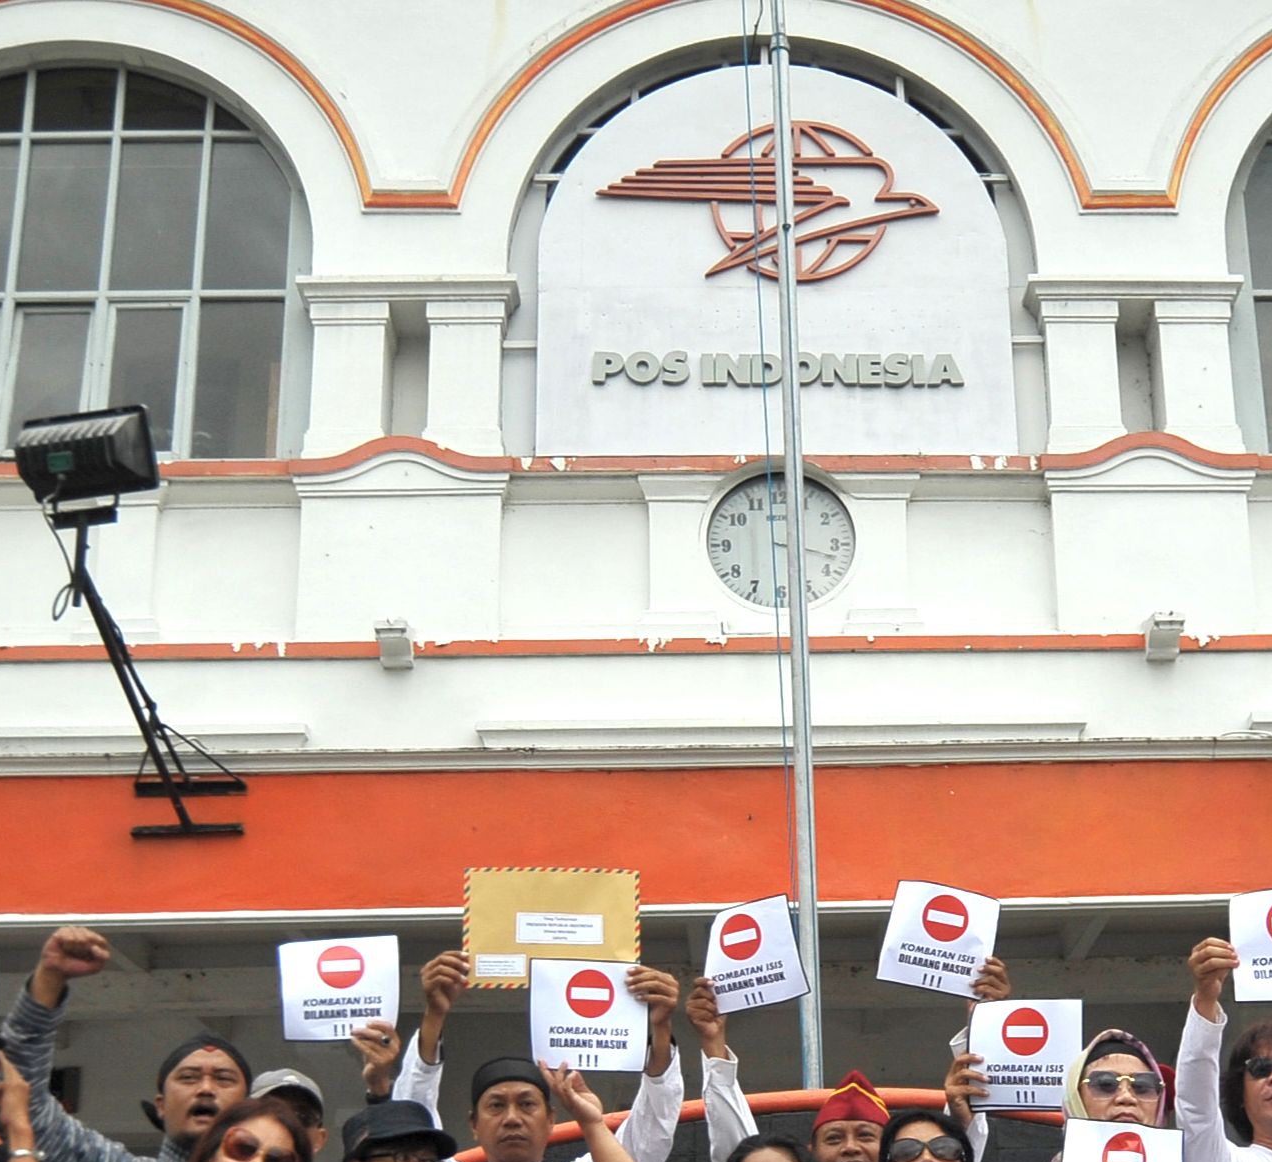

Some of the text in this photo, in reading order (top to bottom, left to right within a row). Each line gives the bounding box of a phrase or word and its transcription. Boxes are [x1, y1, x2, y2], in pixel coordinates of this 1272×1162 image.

[592, 350, 965, 388] POS INDONESIA
[748, 499, 764, 511] 11
[730, 513, 747, 526] 10
[820, 512, 830, 525] 2
[721, 539, 732, 552] 9
[830, 538, 840, 551] 3
[731, 564, 741, 578] 8
[821, 563, 831, 577] 4
[750, 580, 759, 593] 7
[776, 585, 787, 599] 6
[900, 943, 976, 964] KOMBATAN ISIS
[711, 960, 783, 982] KOMBATAN ISIS
[898, 953, 972, 976] DILARANG MASUK
[713, 971, 786, 997] DILARANG MASUK
[303, 996, 382, 1007] KOMBATAN ISIS
[304, 1008, 381, 1020] DILARANG MASUK
[549, 1026, 629, 1037] KOMBATAN ISIS
[549, 1038, 627, 1049] DILARANG MASUK
[986, 1064, 1064, 1073] KOMBATAN ISIS
[987, 1075, 1063, 1086] DILARANG MASUK
